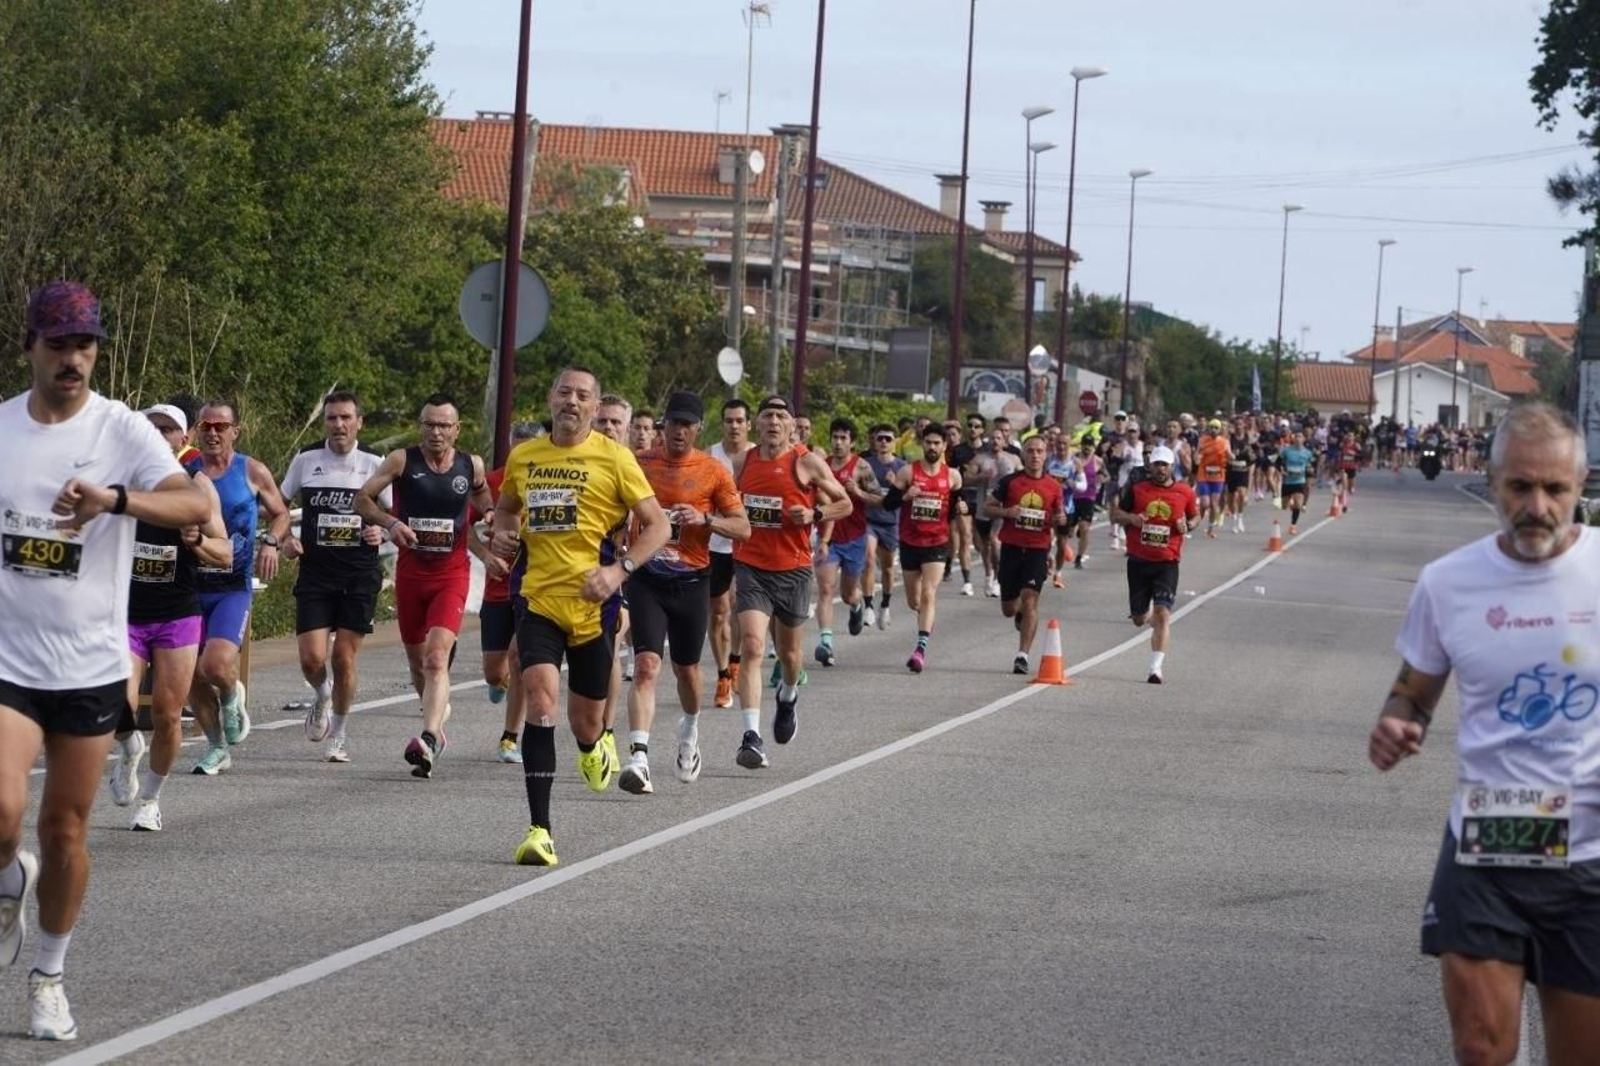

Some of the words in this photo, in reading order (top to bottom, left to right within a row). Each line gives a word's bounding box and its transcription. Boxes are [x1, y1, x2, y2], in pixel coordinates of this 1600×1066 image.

[528, 467, 589, 483] TANINOS
[310, 491, 355, 507] deliki
[540, 506, 566, 521] 475
[751, 508, 772, 520] 271
[329, 527, 352, 539] 222
[19, 538, 65, 564] 430
[136, 559, 165, 573] 815
[1506, 615, 1554, 630] ribera
[1481, 818, 1555, 847] 3327
